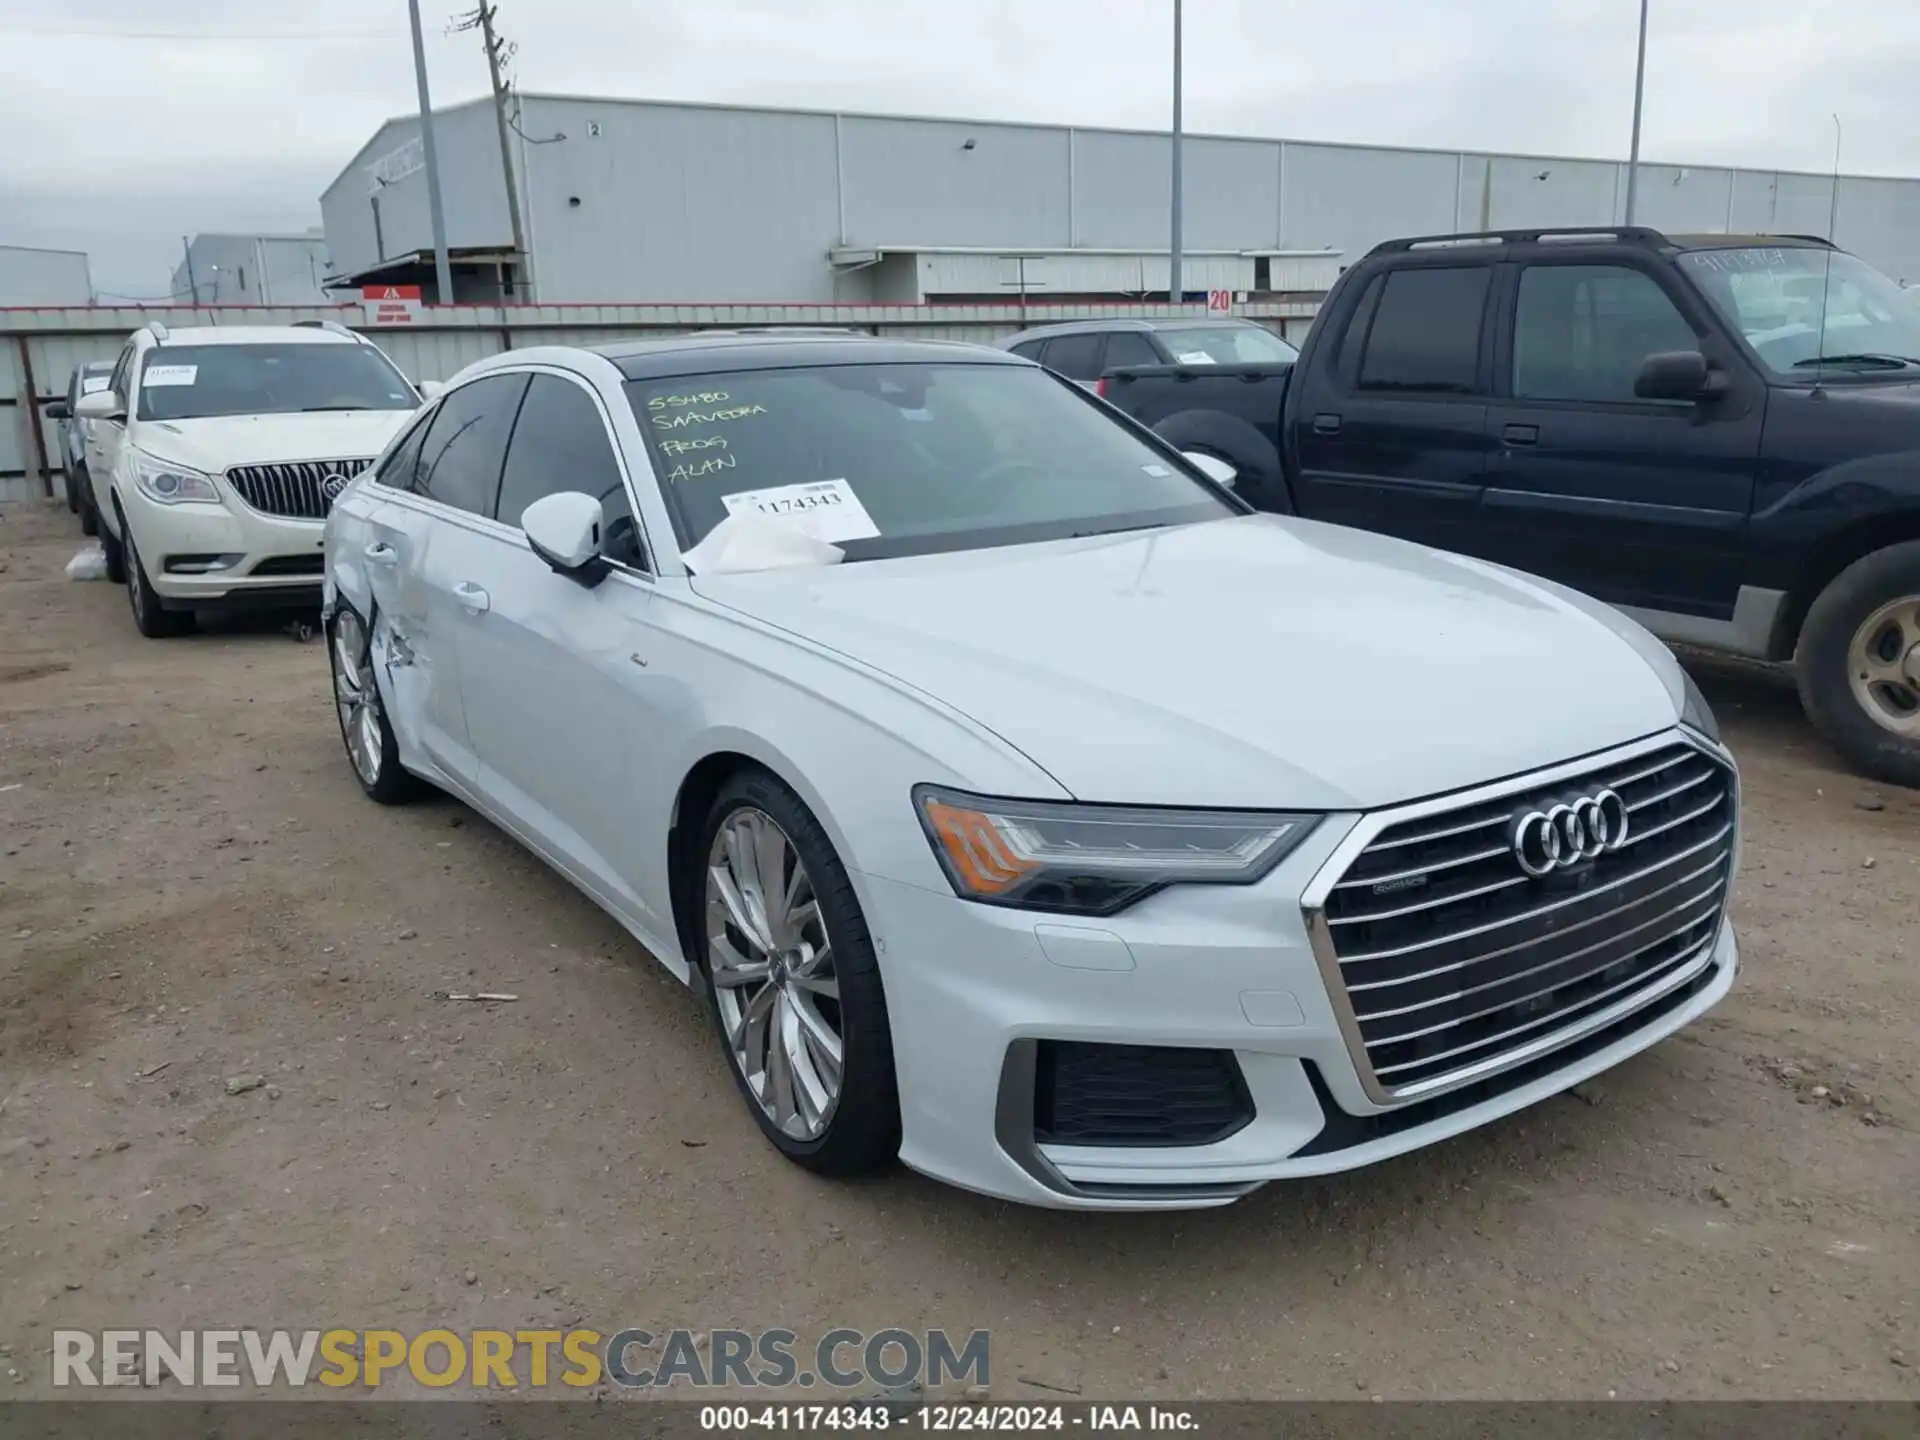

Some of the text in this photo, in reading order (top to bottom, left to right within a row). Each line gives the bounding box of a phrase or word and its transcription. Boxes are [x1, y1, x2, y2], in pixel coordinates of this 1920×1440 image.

[591, 124, 600, 136] 2
[1210, 290, 1229, 311] 20
[668, 453, 736, 485] ALAN
[751, 493, 843, 514] 1174343
